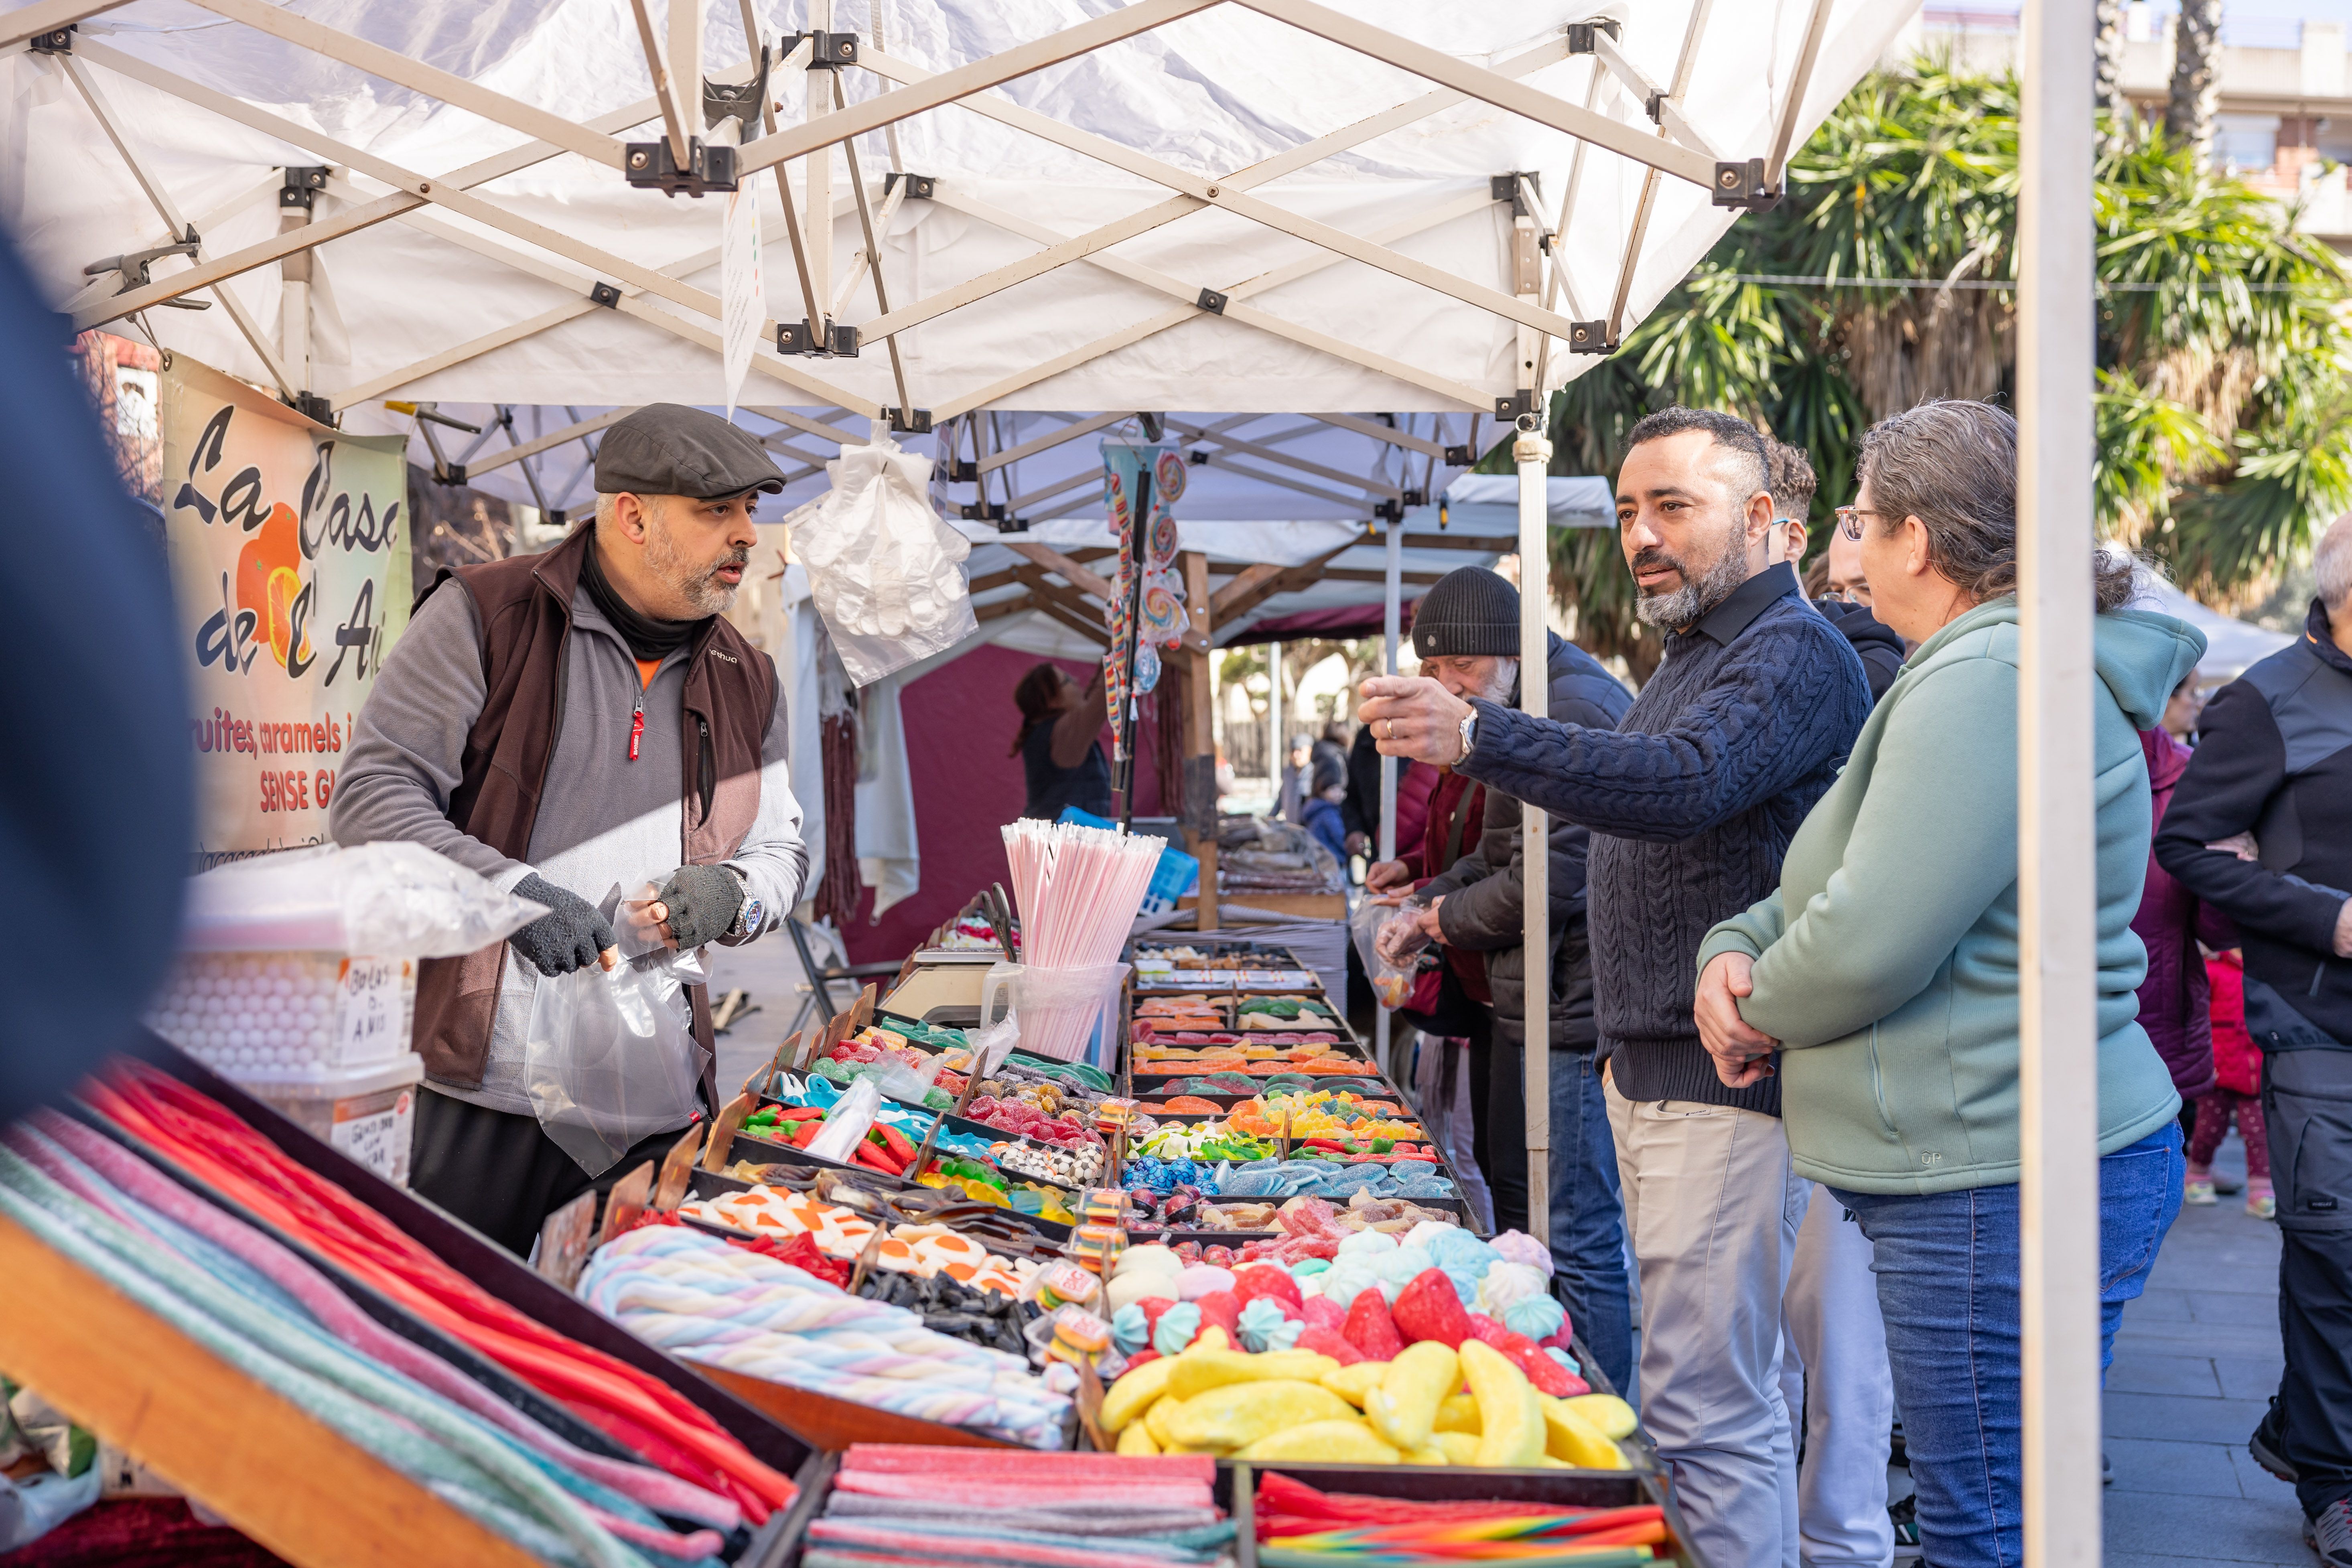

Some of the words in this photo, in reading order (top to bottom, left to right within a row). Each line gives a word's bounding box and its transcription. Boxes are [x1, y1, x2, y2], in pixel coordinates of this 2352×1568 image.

[174, 405, 272, 532] La
[196, 571, 258, 677] de
[260, 771, 308, 812] SENSE
